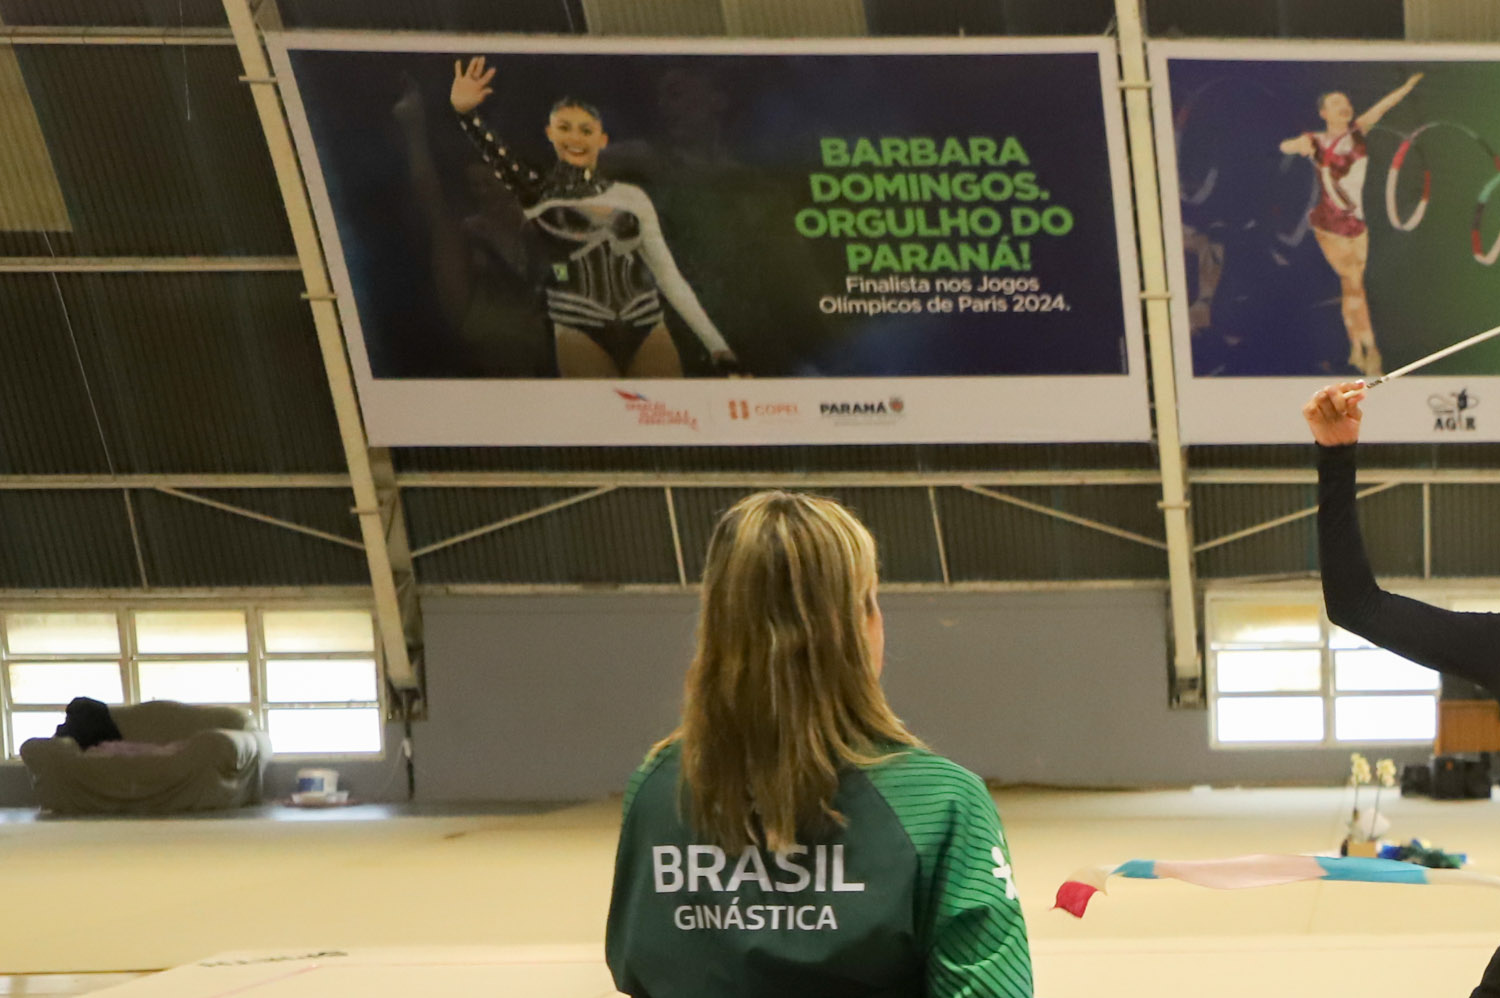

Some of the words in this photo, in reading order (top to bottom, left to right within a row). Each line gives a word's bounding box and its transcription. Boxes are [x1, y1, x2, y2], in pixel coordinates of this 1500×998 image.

[820, 137, 1029, 167] BARBARA
[809, 172, 1049, 202] DOMINGOS.
[795, 207, 1001, 238] ORGULHO
[1010, 206, 1073, 236] DO
[846, 236, 1031, 272] PARANÁ!
[846, 276, 930, 294] Finalista
[935, 279, 972, 293] nos
[978, 276, 1039, 295] Jogos
[819, 296, 922, 315] Olímpicos
[927, 296, 953, 313] de
[958, 296, 1007, 313] Paris
[1012, 294, 1071, 313] 2024.
[819, 400, 887, 415] PARANÁ
[652, 844, 865, 893] BRASIL
[674, 896, 838, 931] GINÁSTICA
